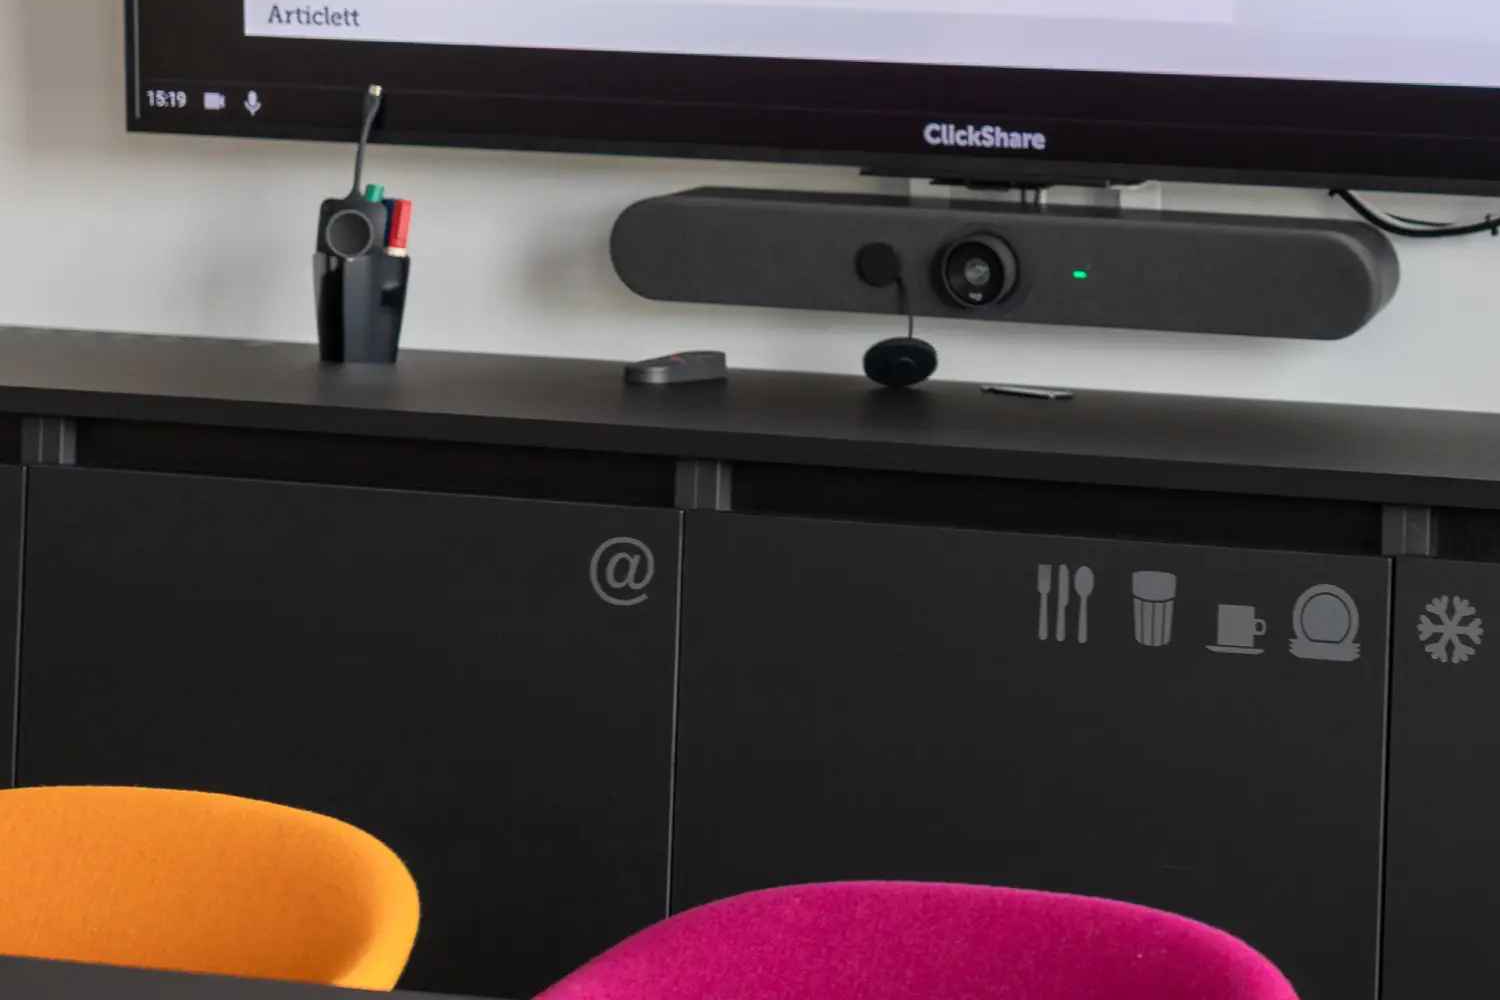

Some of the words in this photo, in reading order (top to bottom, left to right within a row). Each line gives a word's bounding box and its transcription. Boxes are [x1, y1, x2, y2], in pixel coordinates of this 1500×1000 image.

[266, 3, 361, 28] Articlett
[146, 89, 188, 109] 15:19
[922, 121, 1047, 151] ClickShare
